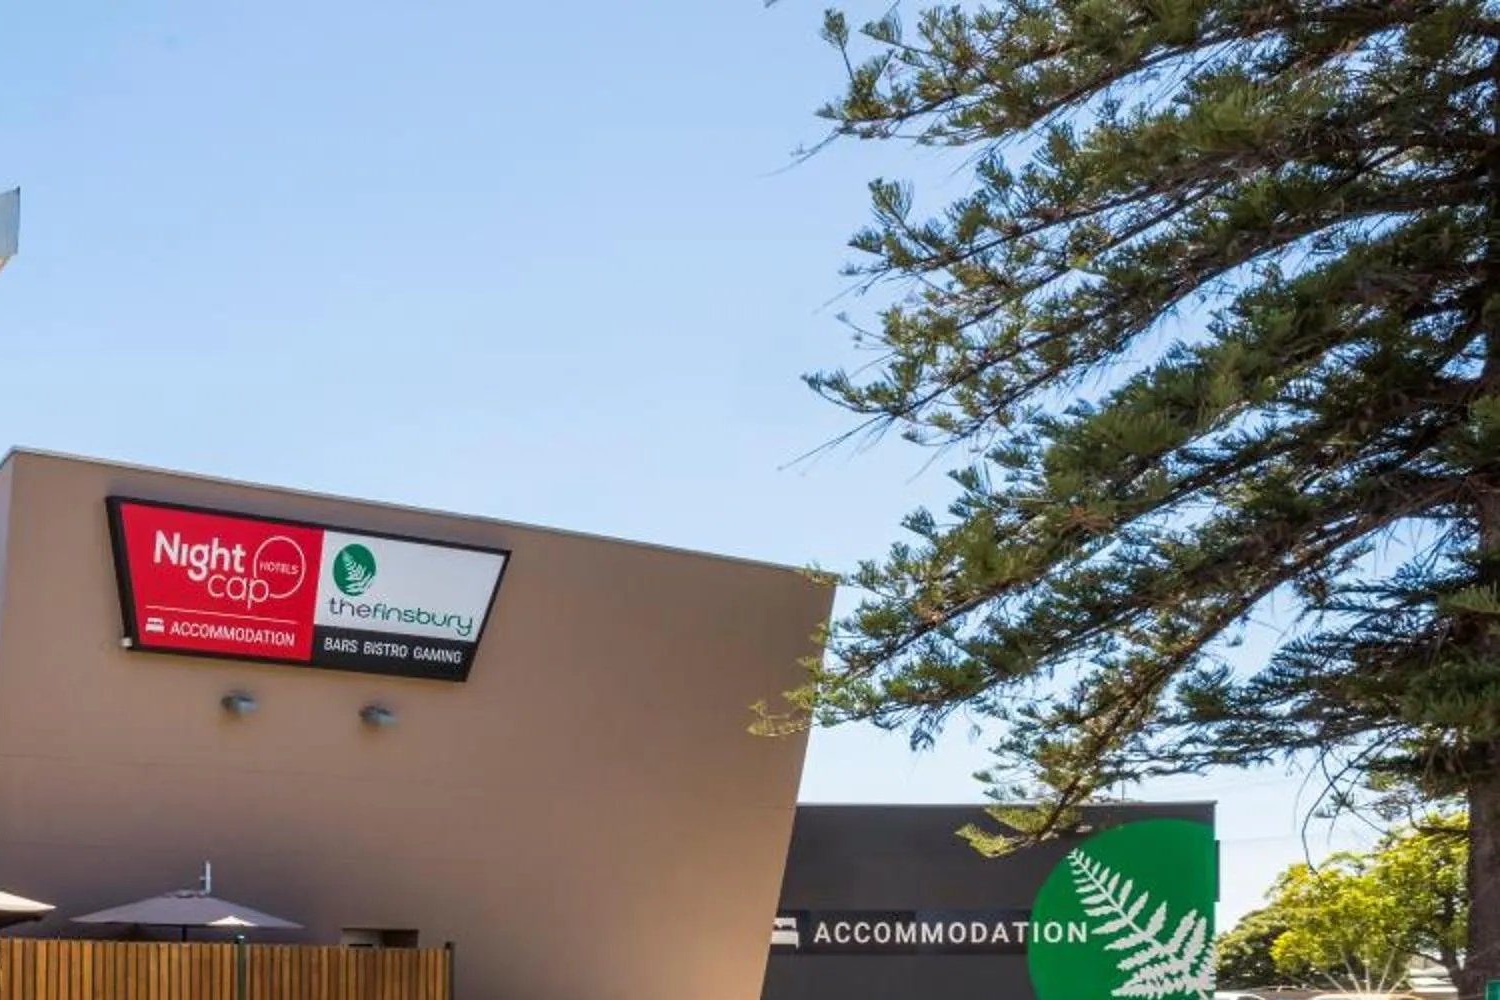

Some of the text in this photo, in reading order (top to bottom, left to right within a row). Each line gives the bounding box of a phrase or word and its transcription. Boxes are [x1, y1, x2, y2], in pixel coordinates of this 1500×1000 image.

[153, 530, 246, 582] Night
[259, 560, 299, 575] HOTELS
[208, 574, 269, 609] cap
[169, 620, 296, 647] ACCOMMODATION
[324, 637, 462, 665] BARS BISTRO GAMING
[813, 919, 1089, 944] ACCOMMODATION
